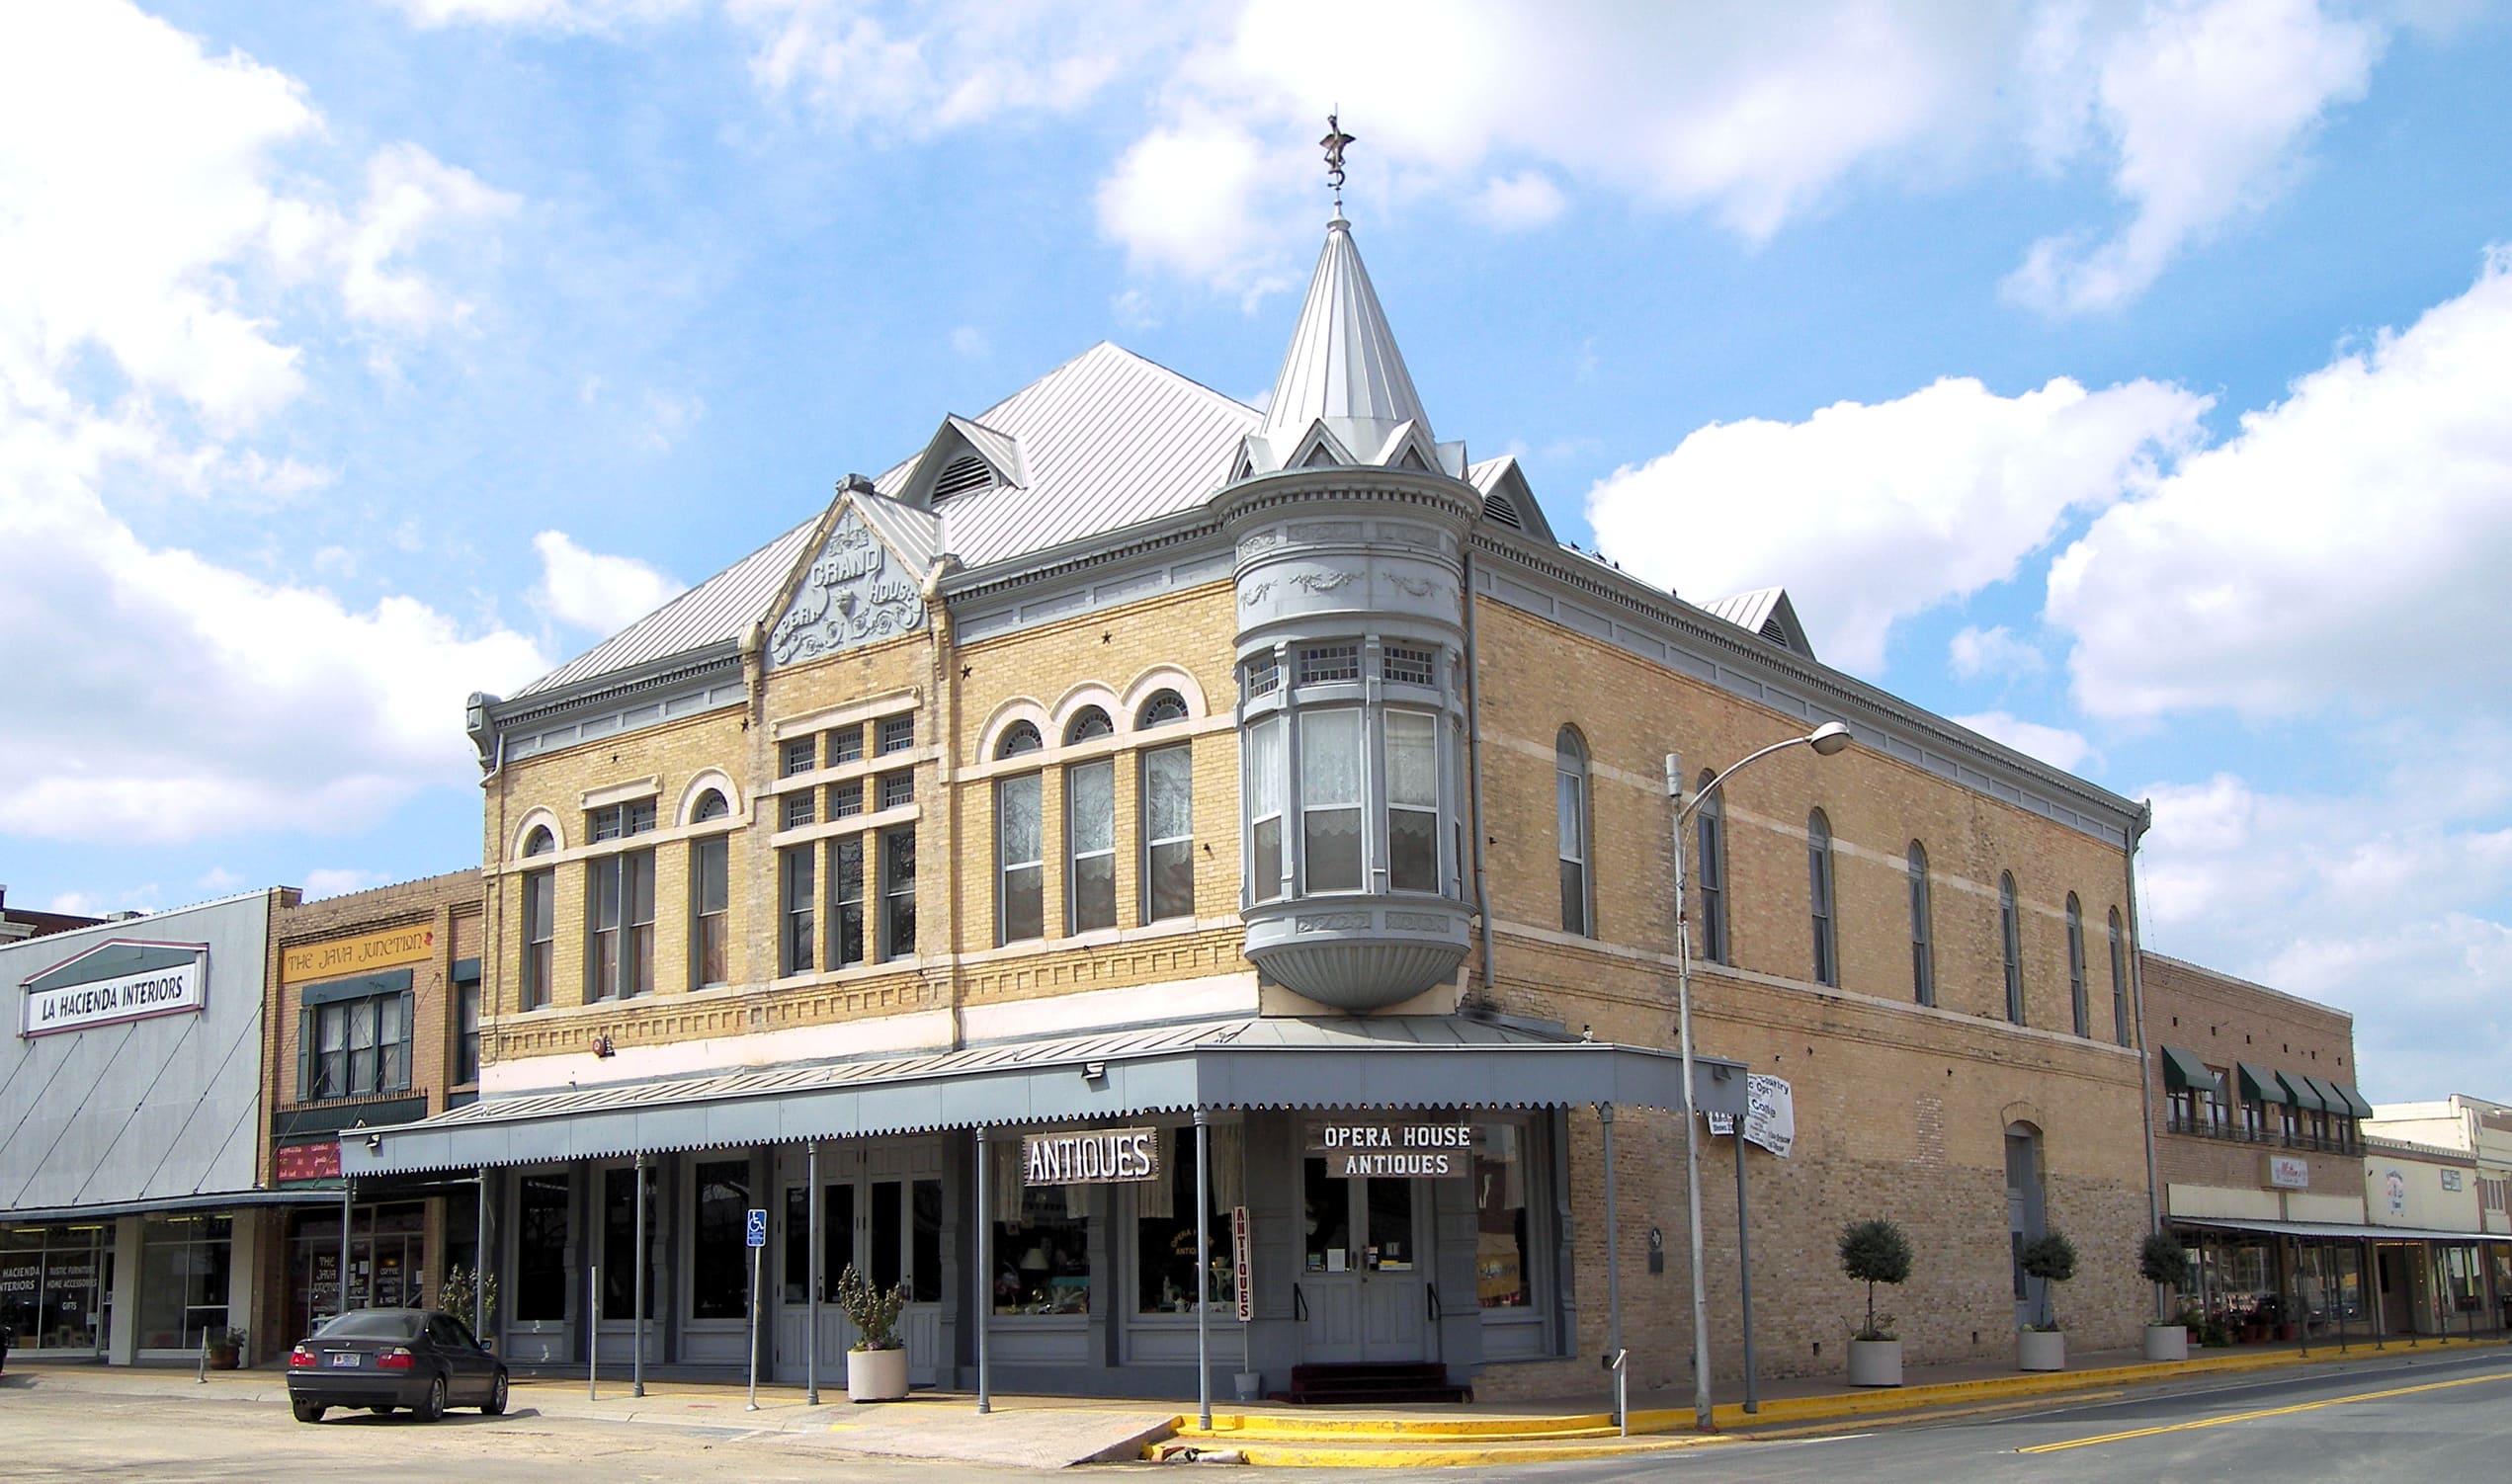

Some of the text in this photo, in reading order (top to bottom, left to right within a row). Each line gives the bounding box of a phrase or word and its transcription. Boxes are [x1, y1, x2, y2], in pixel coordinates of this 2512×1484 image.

[811, 549, 879, 588] GRAND
[772, 581, 917, 644] OPERA HOUSE
[288, 932, 423, 971] THE JAVA JUNCTION
[42, 975, 184, 1022] LA HACIENDA INTERIORS
[1324, 1126, 1471, 1147] OPERA HOUSE
[1029, 1134, 1150, 1181] ANTIQUES
[1345, 1154, 1450, 1175] ANTIQUES
[3, 1267, 41, 1278] HACIENDA
[1236, 1208, 1249, 1317] ANTIQUES
